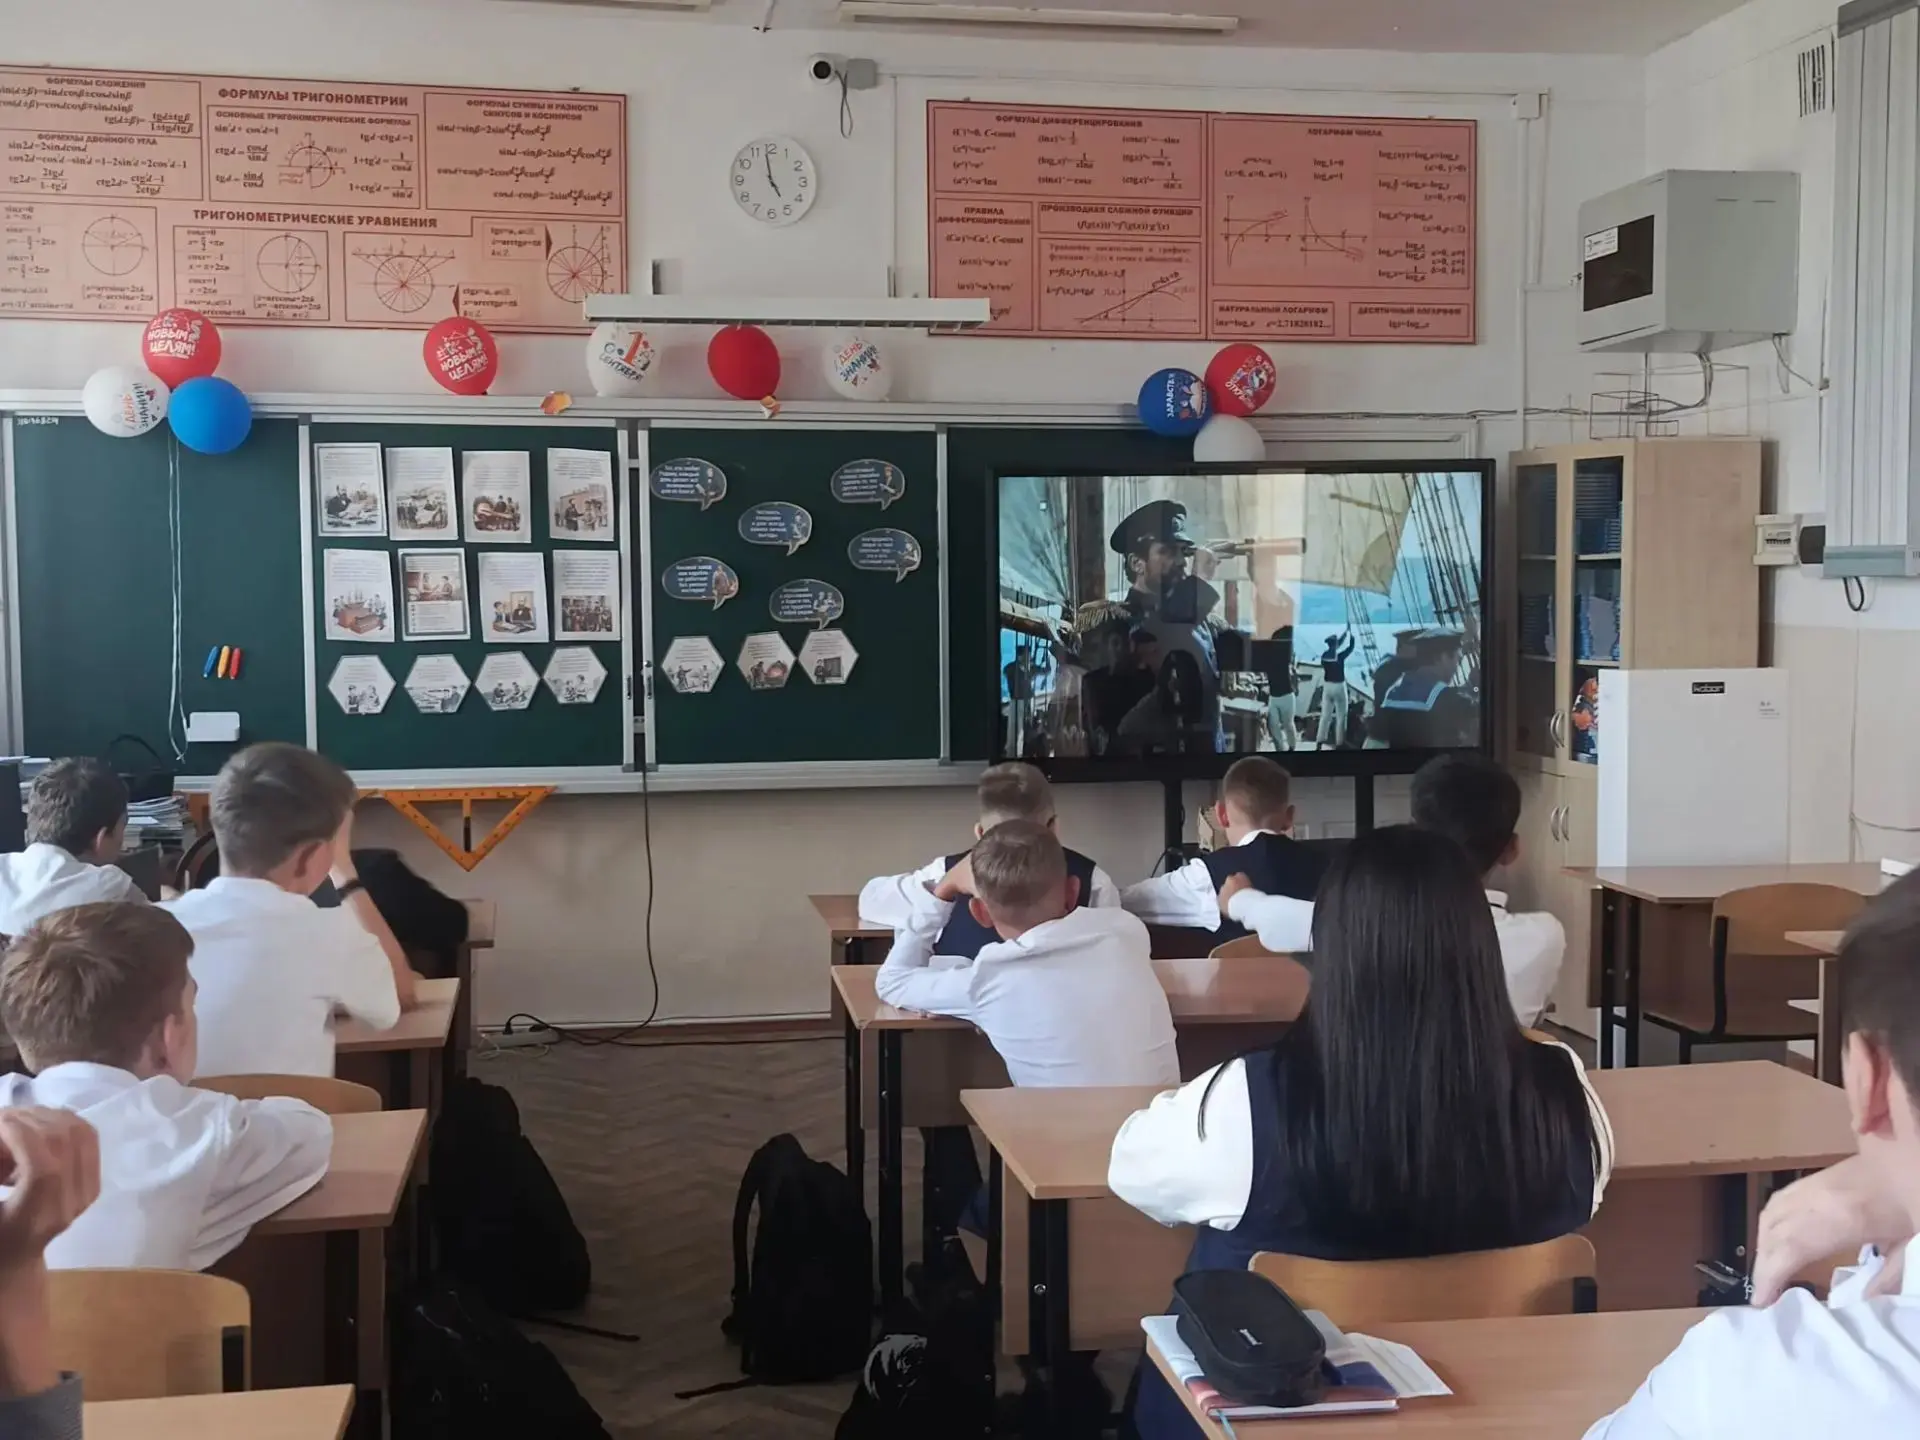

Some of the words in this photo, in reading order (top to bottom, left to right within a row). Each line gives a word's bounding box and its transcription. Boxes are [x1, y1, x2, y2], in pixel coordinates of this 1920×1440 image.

[218, 88, 288, 101] ФОРМУЛЫ
[292, 91, 408, 107] ТРИГОНОМЕТРИИ
[751, 147, 760, 158] 11
[764, 143, 777, 155] 12
[784, 148, 788, 159] 1
[739, 158, 751, 170] 10
[794, 160, 803, 172] 2
[734, 174, 744, 186] 9
[798, 176, 808, 188] 3
[740, 191, 749, 203] 8
[794, 193, 803, 202] 4
[752, 203, 761, 215] 7
[767, 208, 777, 219] 6
[782, 204, 792, 216] 5
[964, 206, 1005, 216] ПРАВИЛА
[192, 209, 356, 227] ТРИГОНОМЕТРИЧЕСКИЕ
[358, 214, 438, 228] УРАВНЕНИЯ
[147, 328, 189, 342] НОВЫМ
[150, 340, 197, 357] ЦЕЛЯМ!
[839, 342, 864, 366] ДЕНЬ
[440, 346, 479, 372] НОВЫМ
[448, 350, 489, 380] ЦЕЛЯМ!
[123, 393, 136, 424] ДЕНЬ
